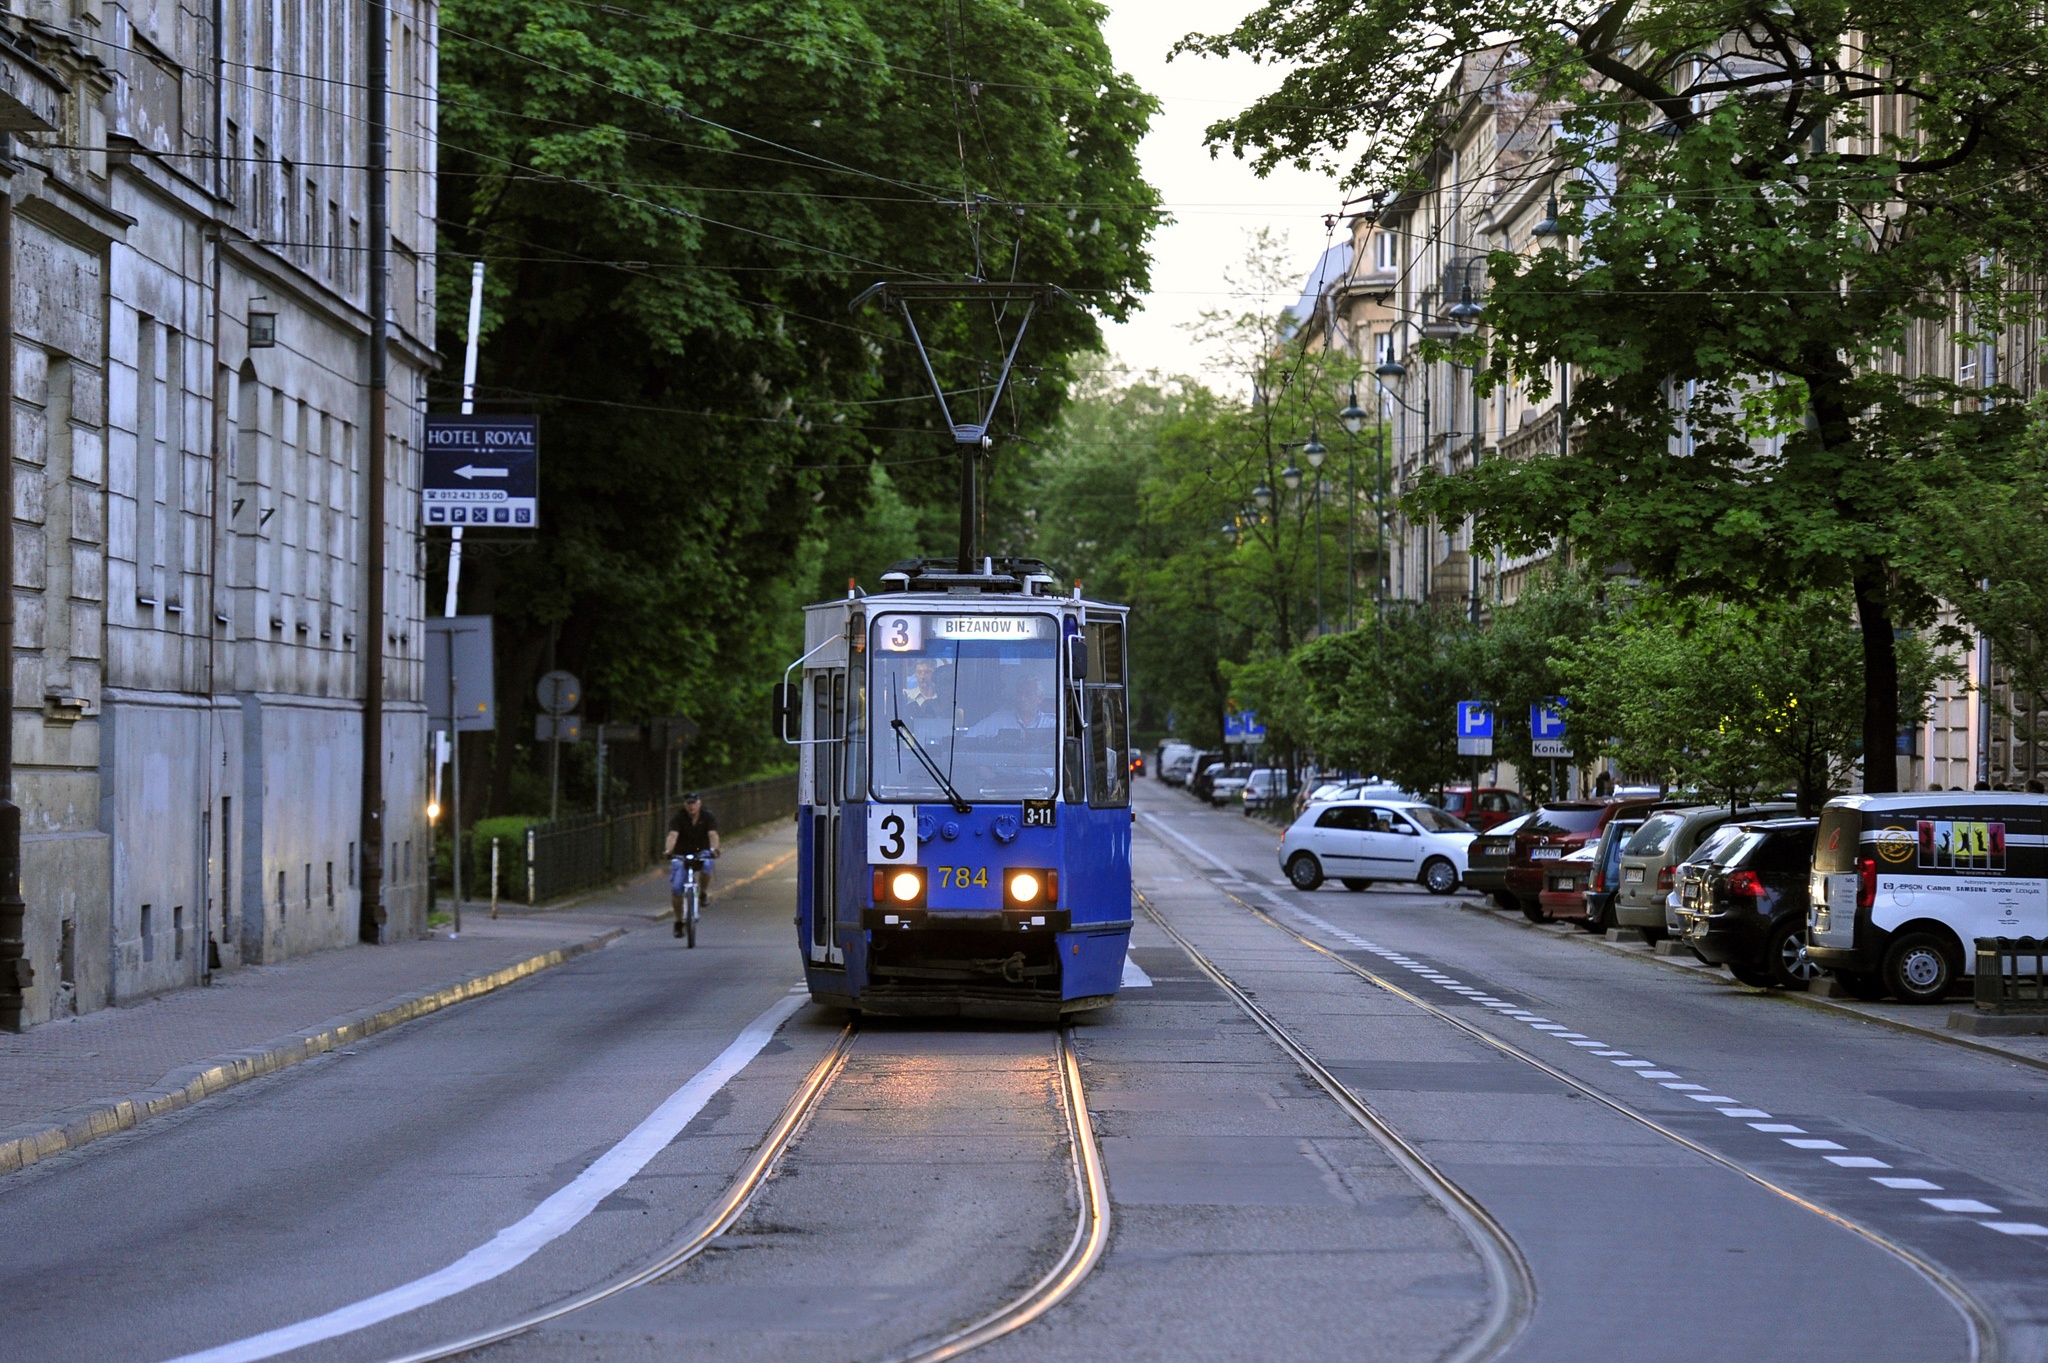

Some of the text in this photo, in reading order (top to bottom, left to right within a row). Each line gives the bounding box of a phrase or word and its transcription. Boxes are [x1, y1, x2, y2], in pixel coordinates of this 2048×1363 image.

[428, 430, 535, 446] HOTEL ROYAL
[441, 491, 504, 499] 012 421 35 00
[891, 618, 910, 647] 3
[945, 617, 1030, 633] BIEŻANÓW N.
[1027, 808, 1051, 824] 3-11
[879, 815, 905, 859] 3
[938, 867, 989, 889] 784
